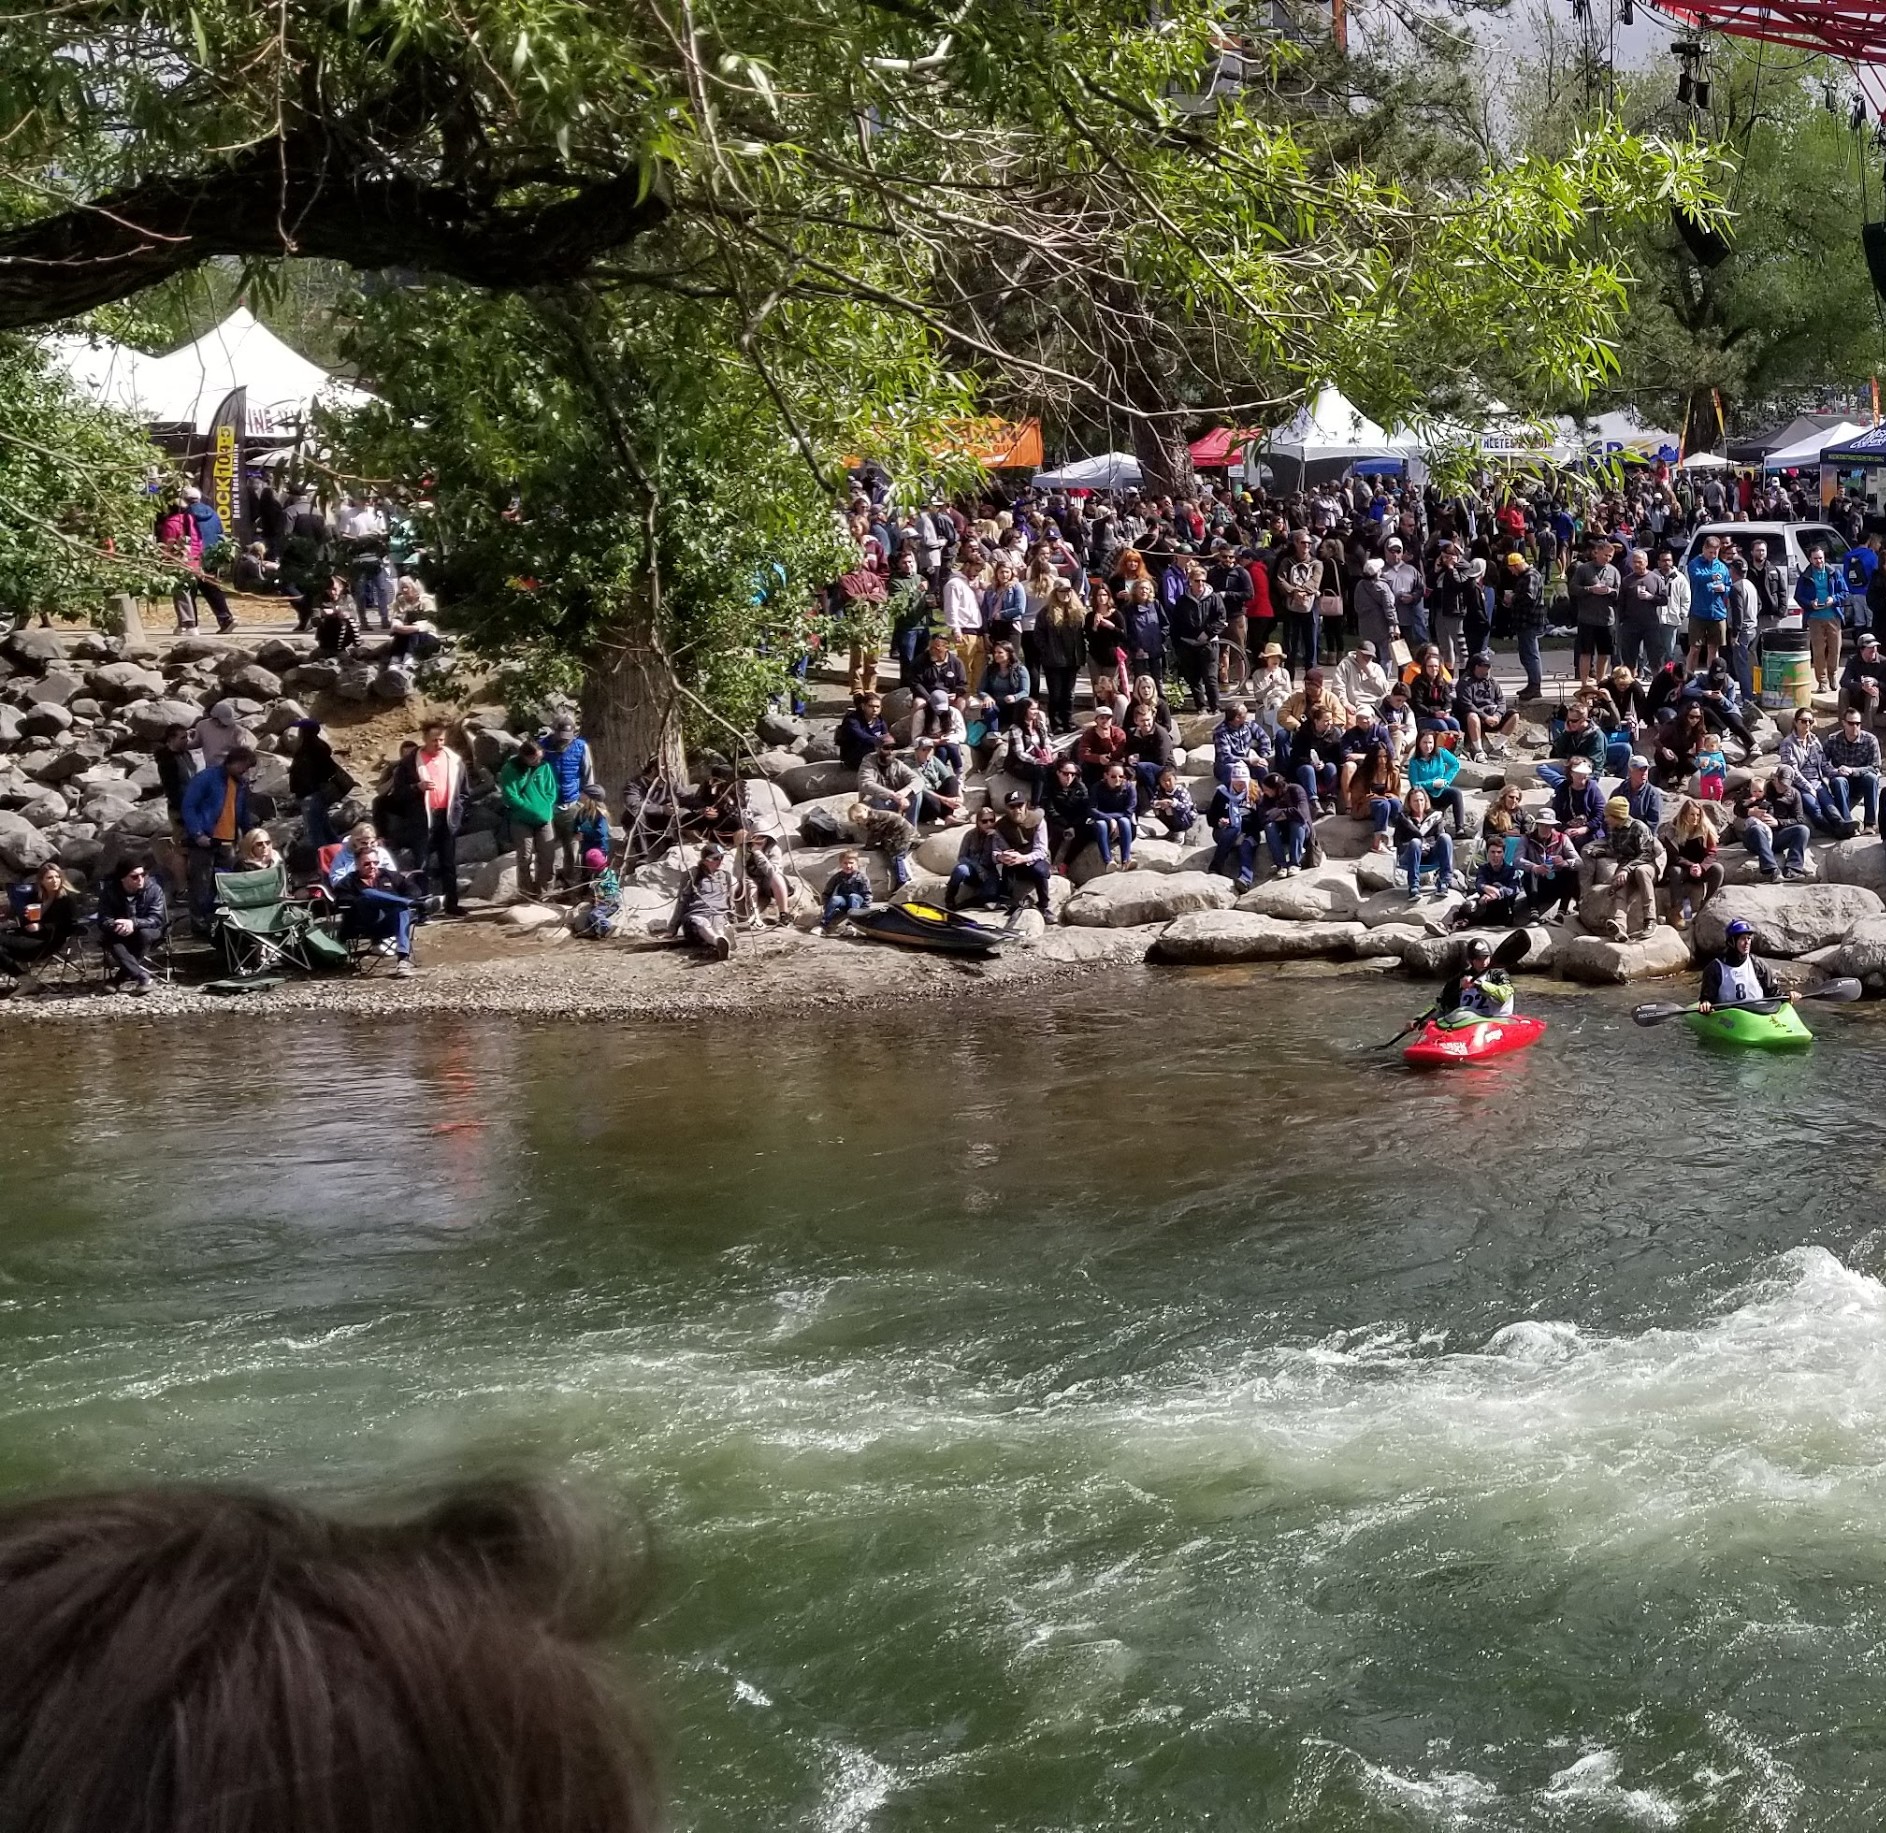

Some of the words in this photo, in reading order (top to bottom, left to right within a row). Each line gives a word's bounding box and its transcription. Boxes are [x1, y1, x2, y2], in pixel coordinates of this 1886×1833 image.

[216, 477, 232, 533] ROCK
[1735, 983, 1747, 1000] 8
[1463, 994, 1490, 1010] 22
